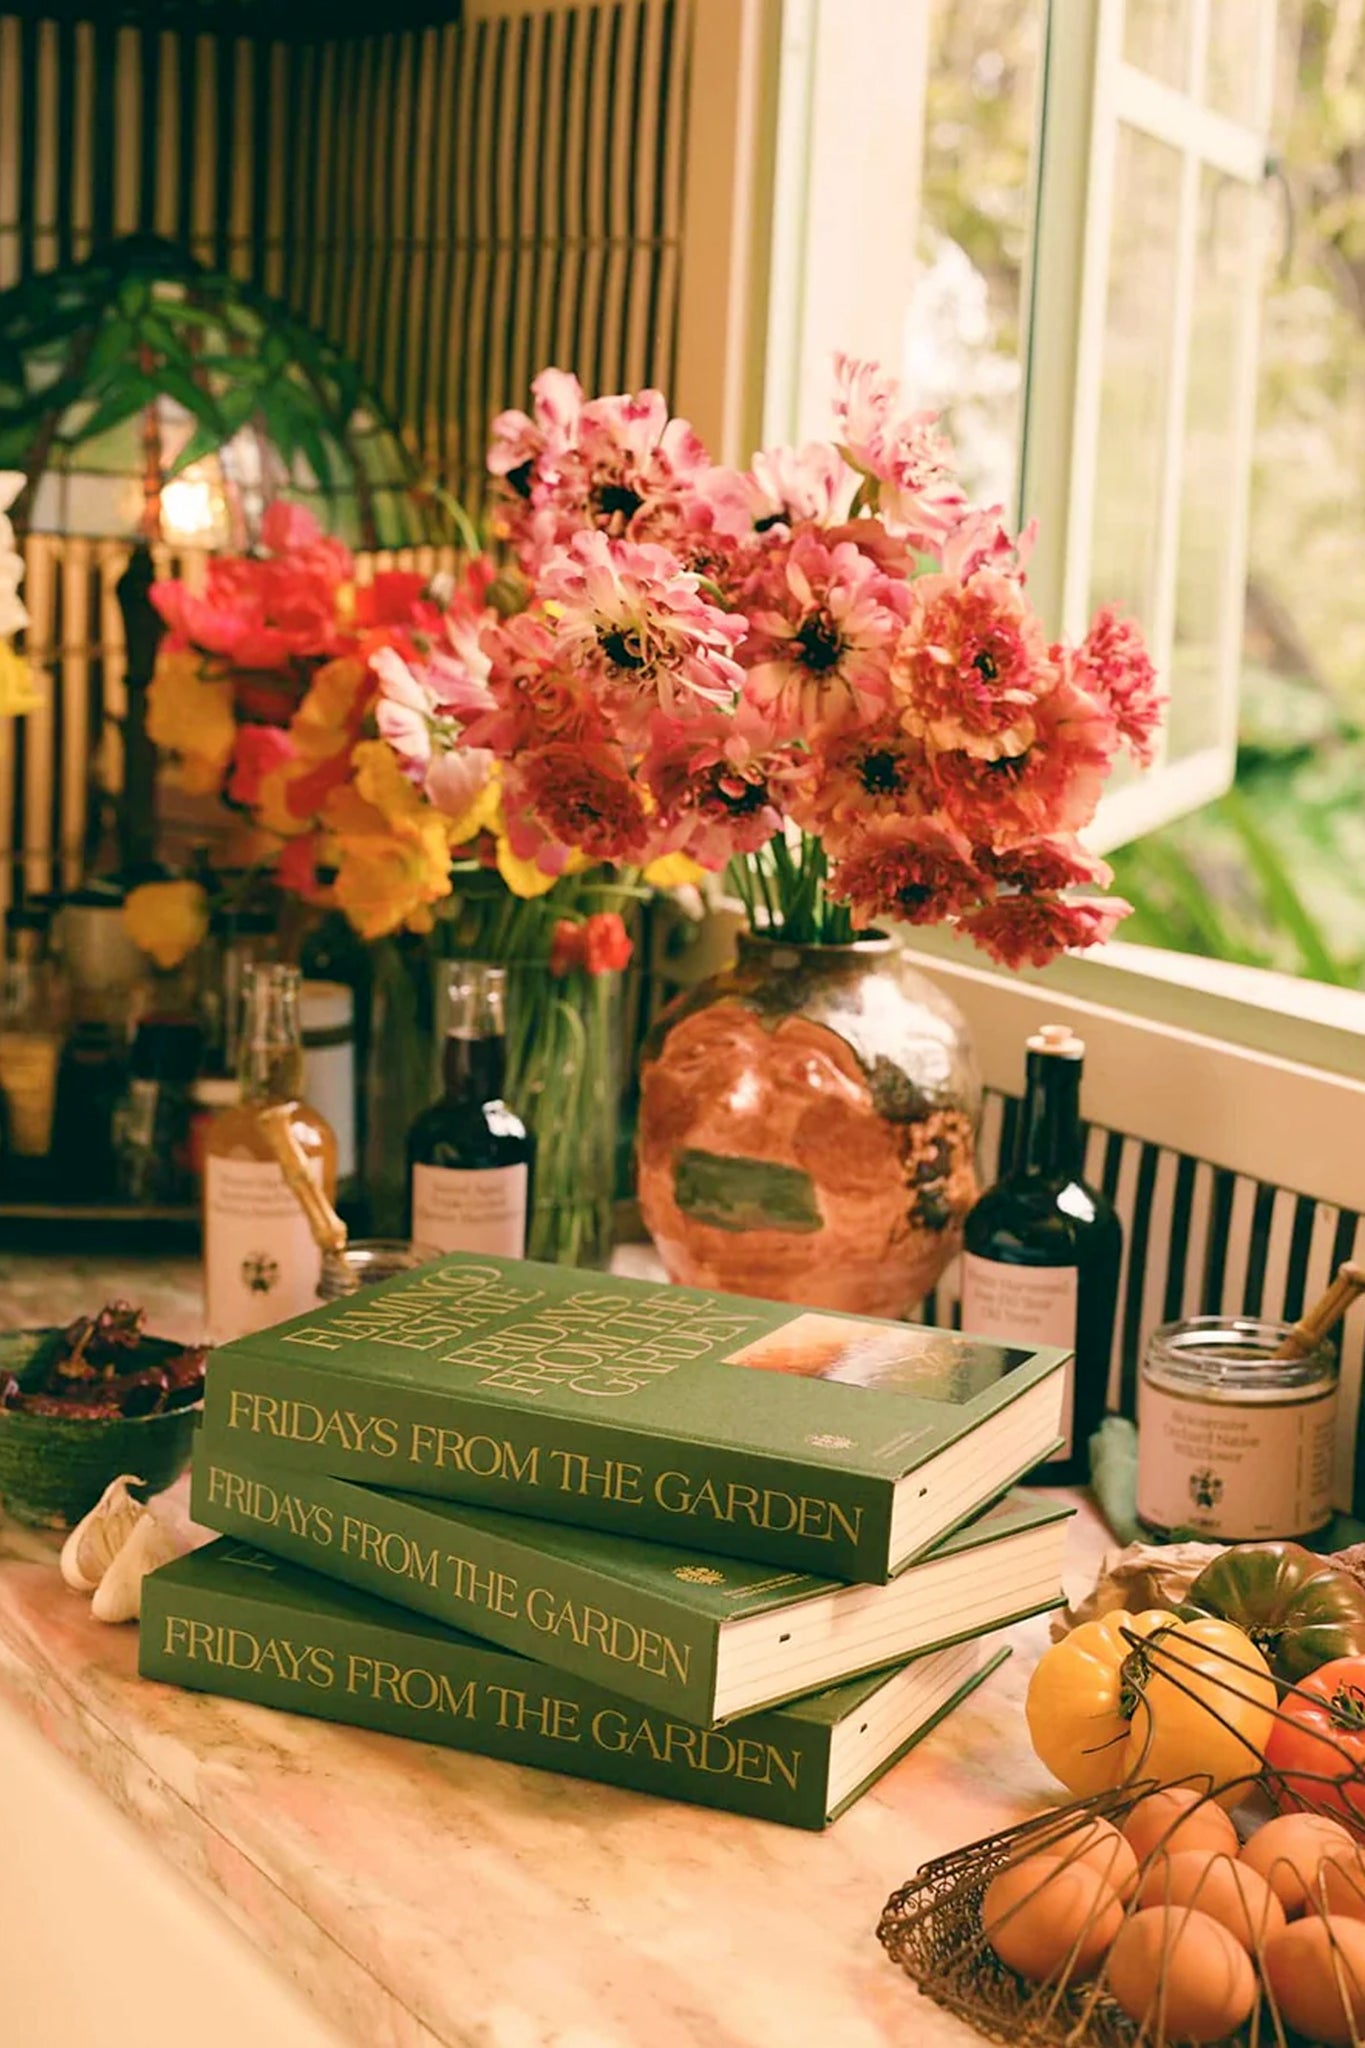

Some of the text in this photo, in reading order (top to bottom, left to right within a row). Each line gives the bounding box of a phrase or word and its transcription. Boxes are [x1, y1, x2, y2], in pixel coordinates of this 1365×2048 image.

[281, 1265, 501, 1350] FLAMINGO
[370, 1284, 545, 1350] ESTATE
[439, 1291, 631, 1371] FRIDAYS
[478, 1292, 717, 1395] FROM THE
[568, 1308, 765, 1396] GARDEN
[227, 1391, 864, 1546] FRIDAYS FROM THE GARDEN
[208, 1466, 693, 1686] FRIDAYS FROM THE GARDEN
[162, 1616, 802, 1790] FRIDAYS FROM THE GARDEN
